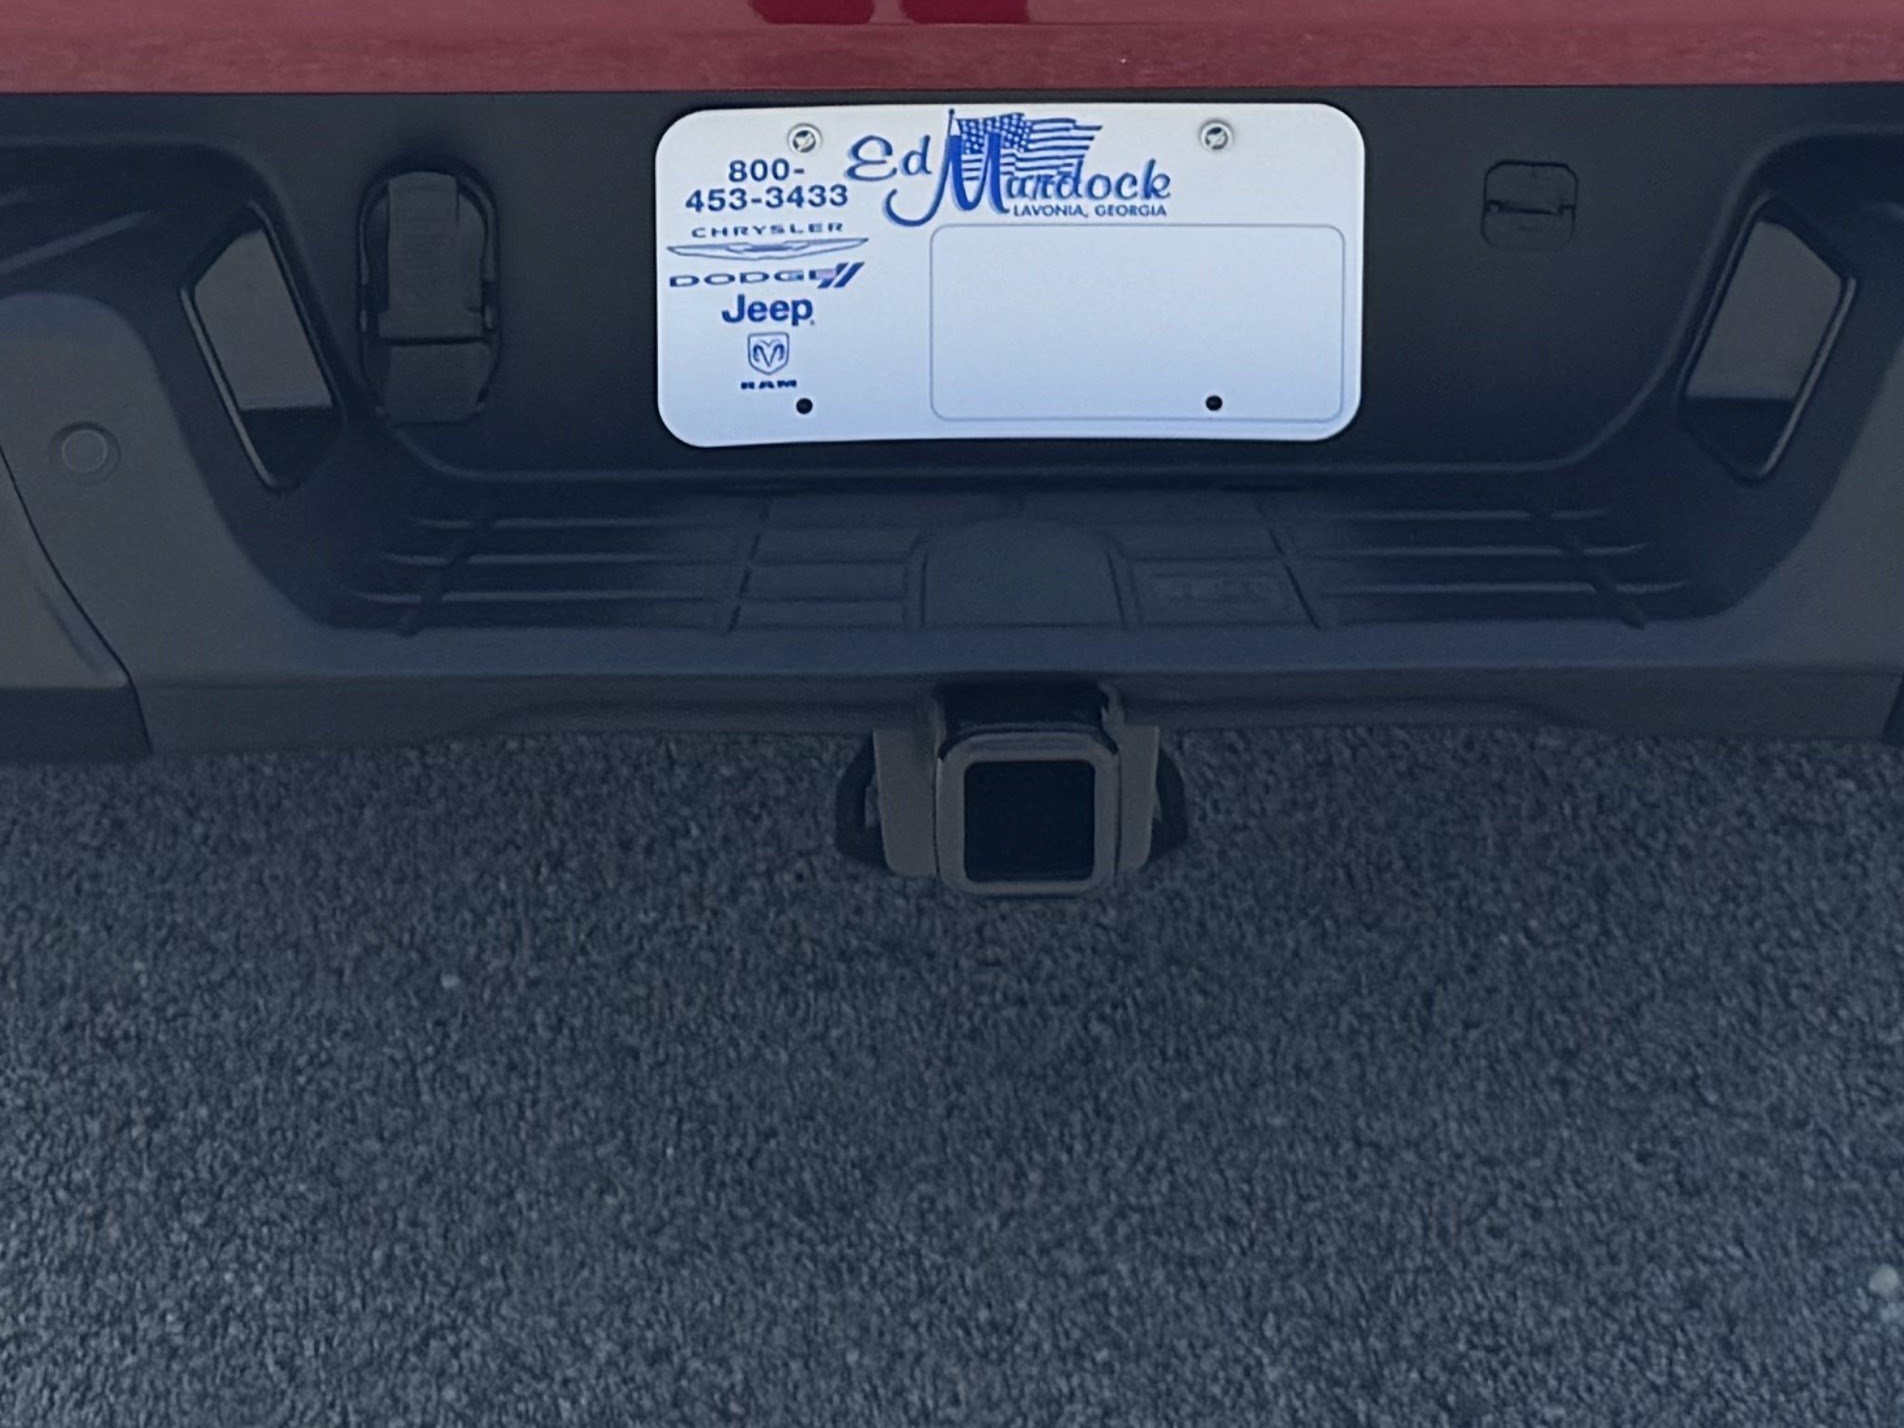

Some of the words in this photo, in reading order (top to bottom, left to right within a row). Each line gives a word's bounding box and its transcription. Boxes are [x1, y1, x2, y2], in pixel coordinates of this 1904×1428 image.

[728, 158, 805, 183] 800-
[844, 134, 933, 183] Ed
[882, 112, 1172, 227] Murdock
[684, 184, 849, 213] 453-3433
[1013, 204, 1089, 218] LAVONIA,
[1094, 204, 1167, 218] GEORGIA
[691, 222, 844, 239] CHRYSLER
[669, 269, 838, 288] DODGE
[721, 293, 814, 327] Jeep
[740, 379, 798, 390] RAM
